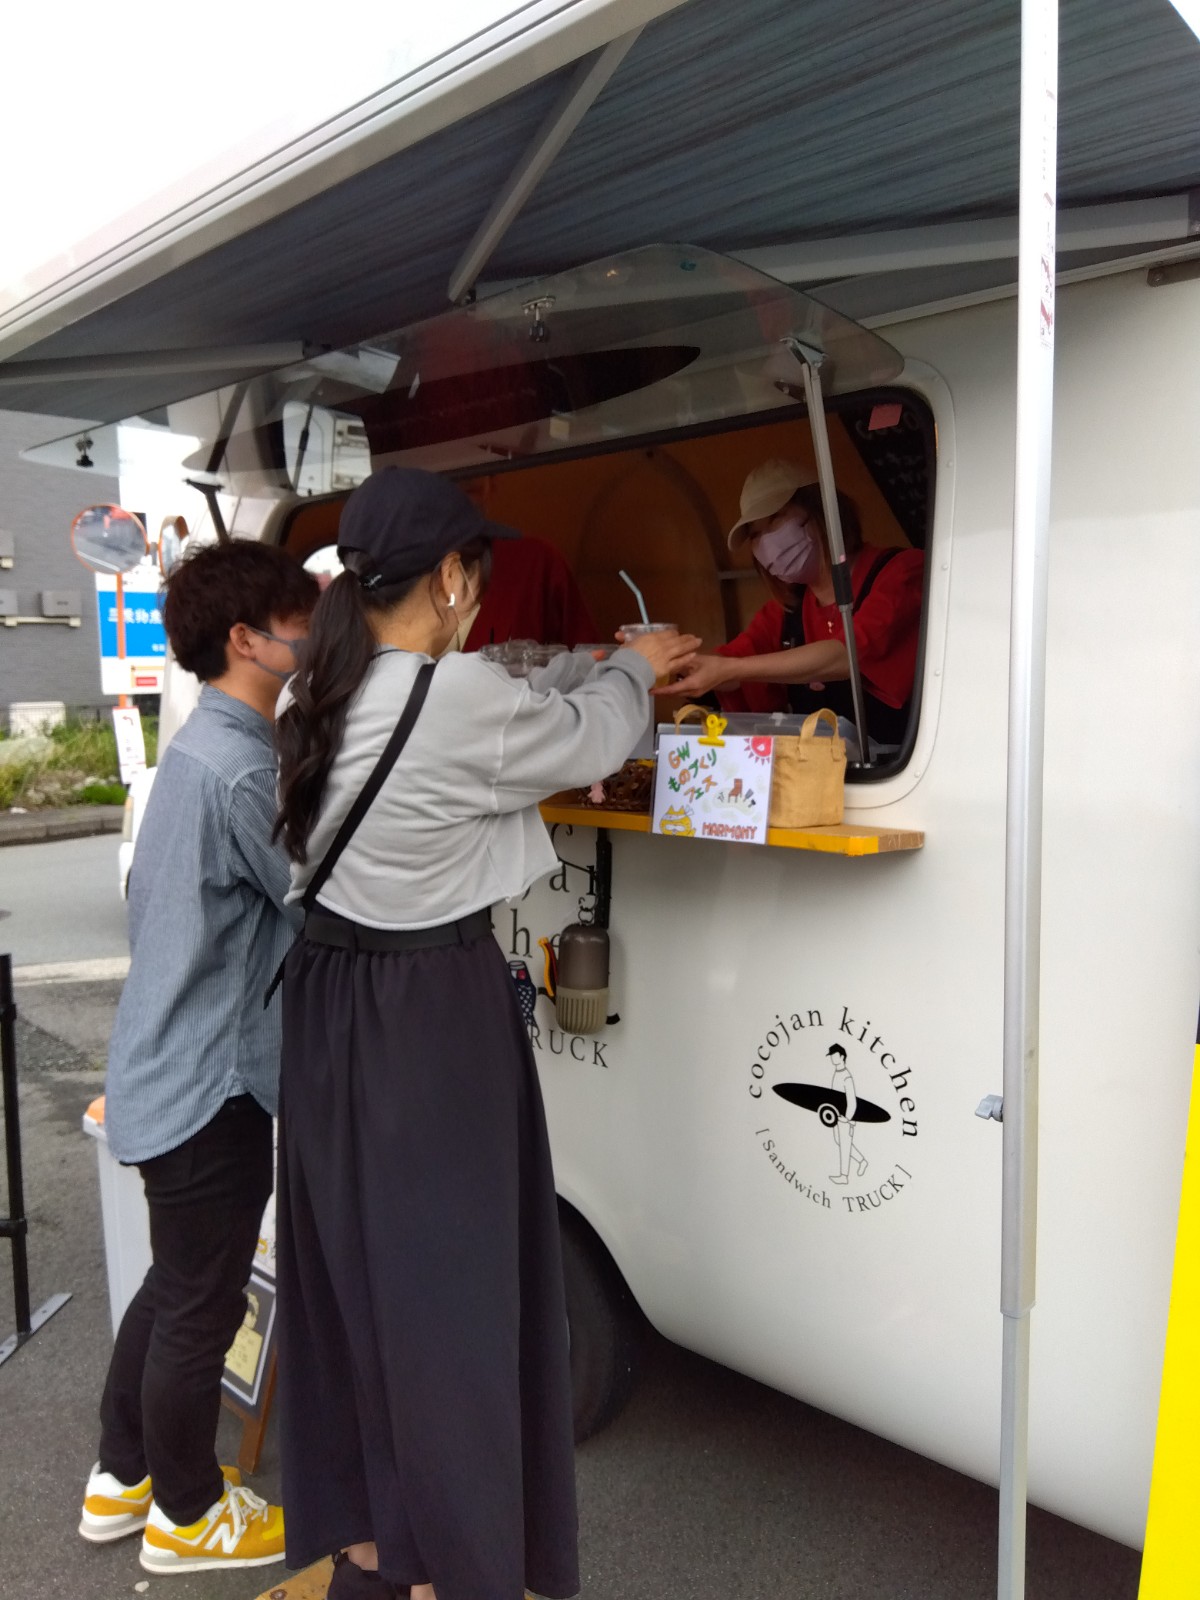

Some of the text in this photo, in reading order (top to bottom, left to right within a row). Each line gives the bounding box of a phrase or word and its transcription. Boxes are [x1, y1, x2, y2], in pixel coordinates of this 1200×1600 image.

[669, 741, 690, 769] GW
[683, 774, 718, 804] フェス
[530, 1025, 608, 1069] RUCK
[748, 1005, 918, 1138] cocojan kitchen
